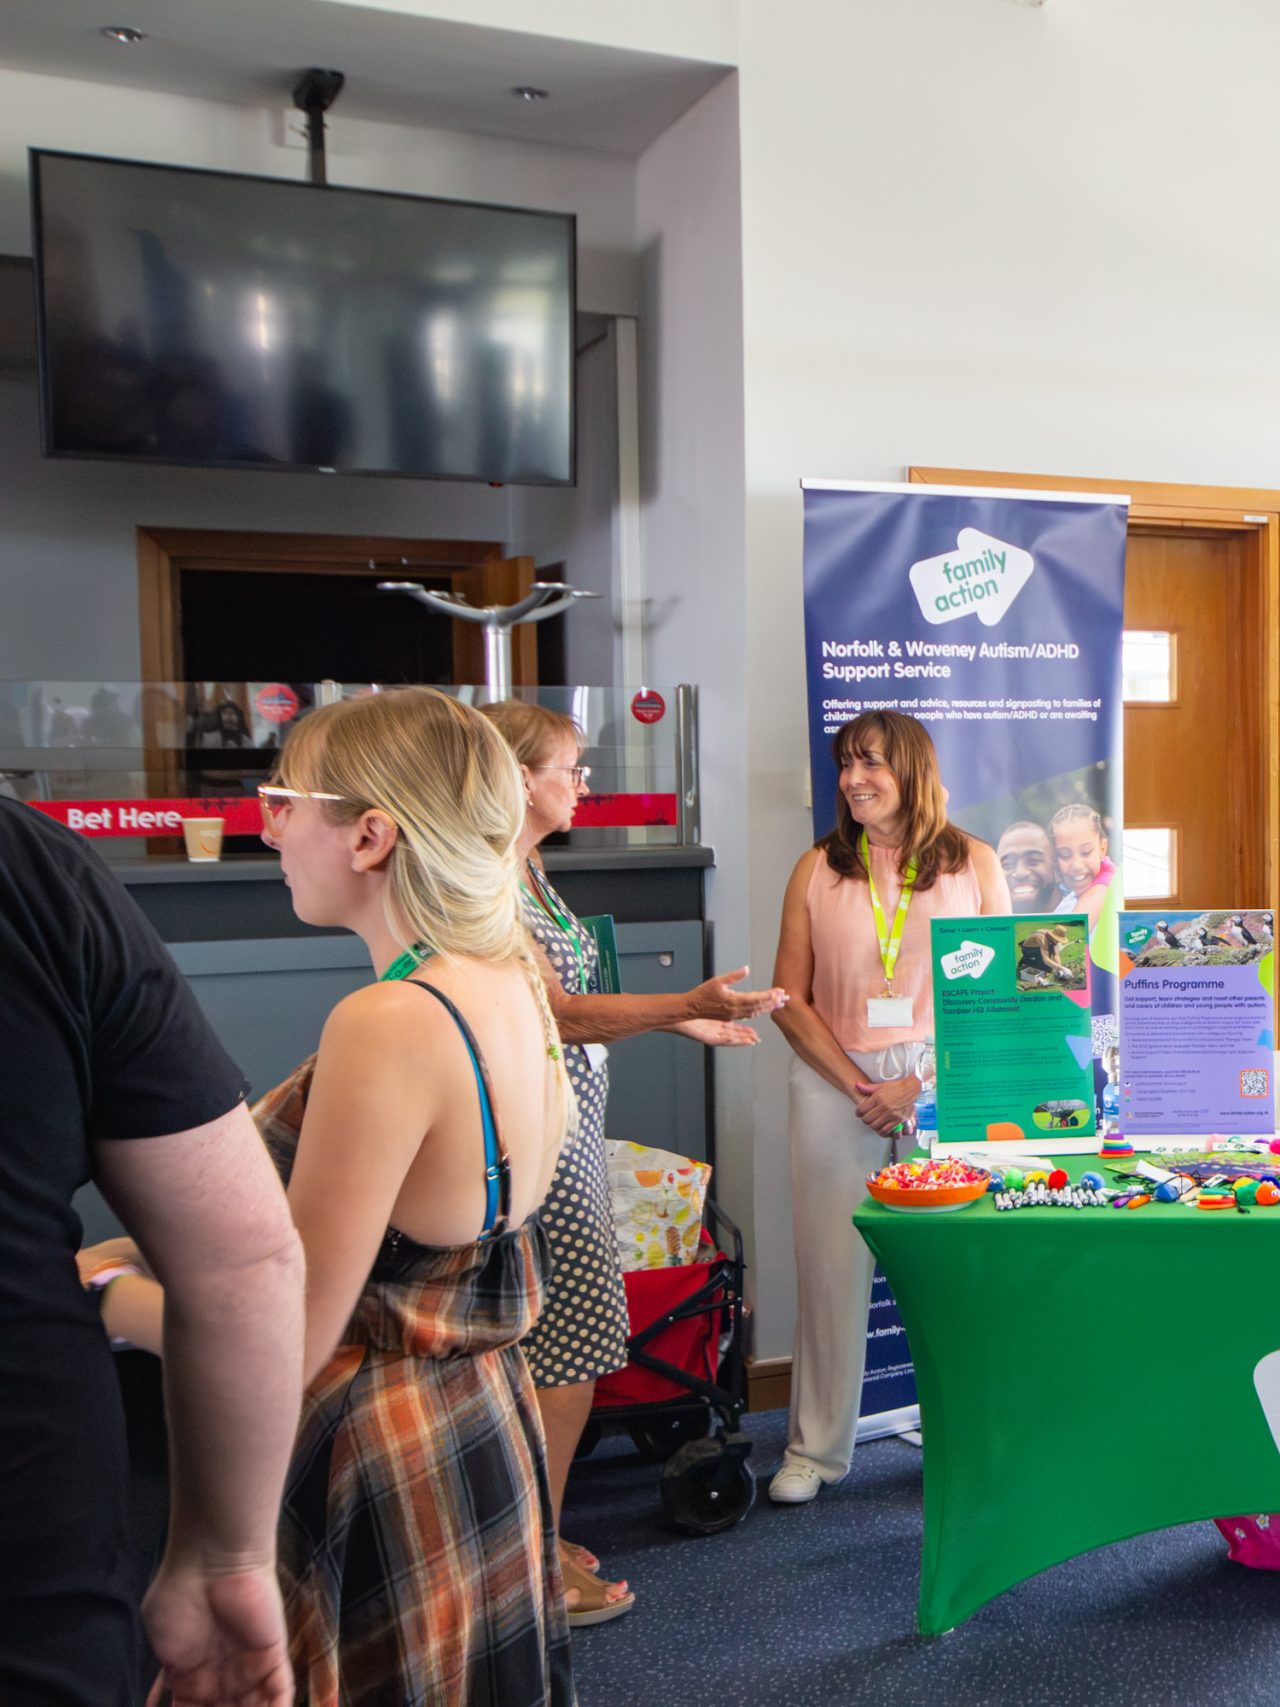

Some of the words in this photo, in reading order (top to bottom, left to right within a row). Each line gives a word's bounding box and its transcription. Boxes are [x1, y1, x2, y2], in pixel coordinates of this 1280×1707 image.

[942, 548, 1007, 584] family
[934, 576, 999, 613] action
[822, 640, 884, 658] Norfolk
[887, 640, 902, 658] &
[905, 640, 976, 662] Waveney
[979, 642, 1080, 660] Autism/ADHD
[823, 661, 891, 682] Support
[894, 661, 952, 679] Service
[822, 700, 862, 711] Offering
[863, 699, 899, 710] support
[900, 698, 919, 708] and
[920, 698, 950, 709] advice,
[951, 699, 987, 708] resources
[988, 698, 1005, 708] and
[1005, 698, 1052, 710] signposting
[1053, 698, 1062, 708] to
[1063, 698, 1090, 708] families
[1092, 698, 1102, 708] of
[914, 710, 944, 721] people
[945, 710, 962, 720] who
[963, 710, 982, 720] have
[983, 710, 1038, 721] autism/ADHD
[1039, 712, 1049, 720] or
[1050, 712, 1063, 720] are
[1064, 710, 1098, 721] awaiting
[67, 808, 113, 829] Bet
[118, 807, 183, 829] Here
[954, 947, 984, 964] family
[950, 958, 981, 975] action
[1124, 979, 1160, 990] Puffins
[1162, 979, 1225, 991] Programme
